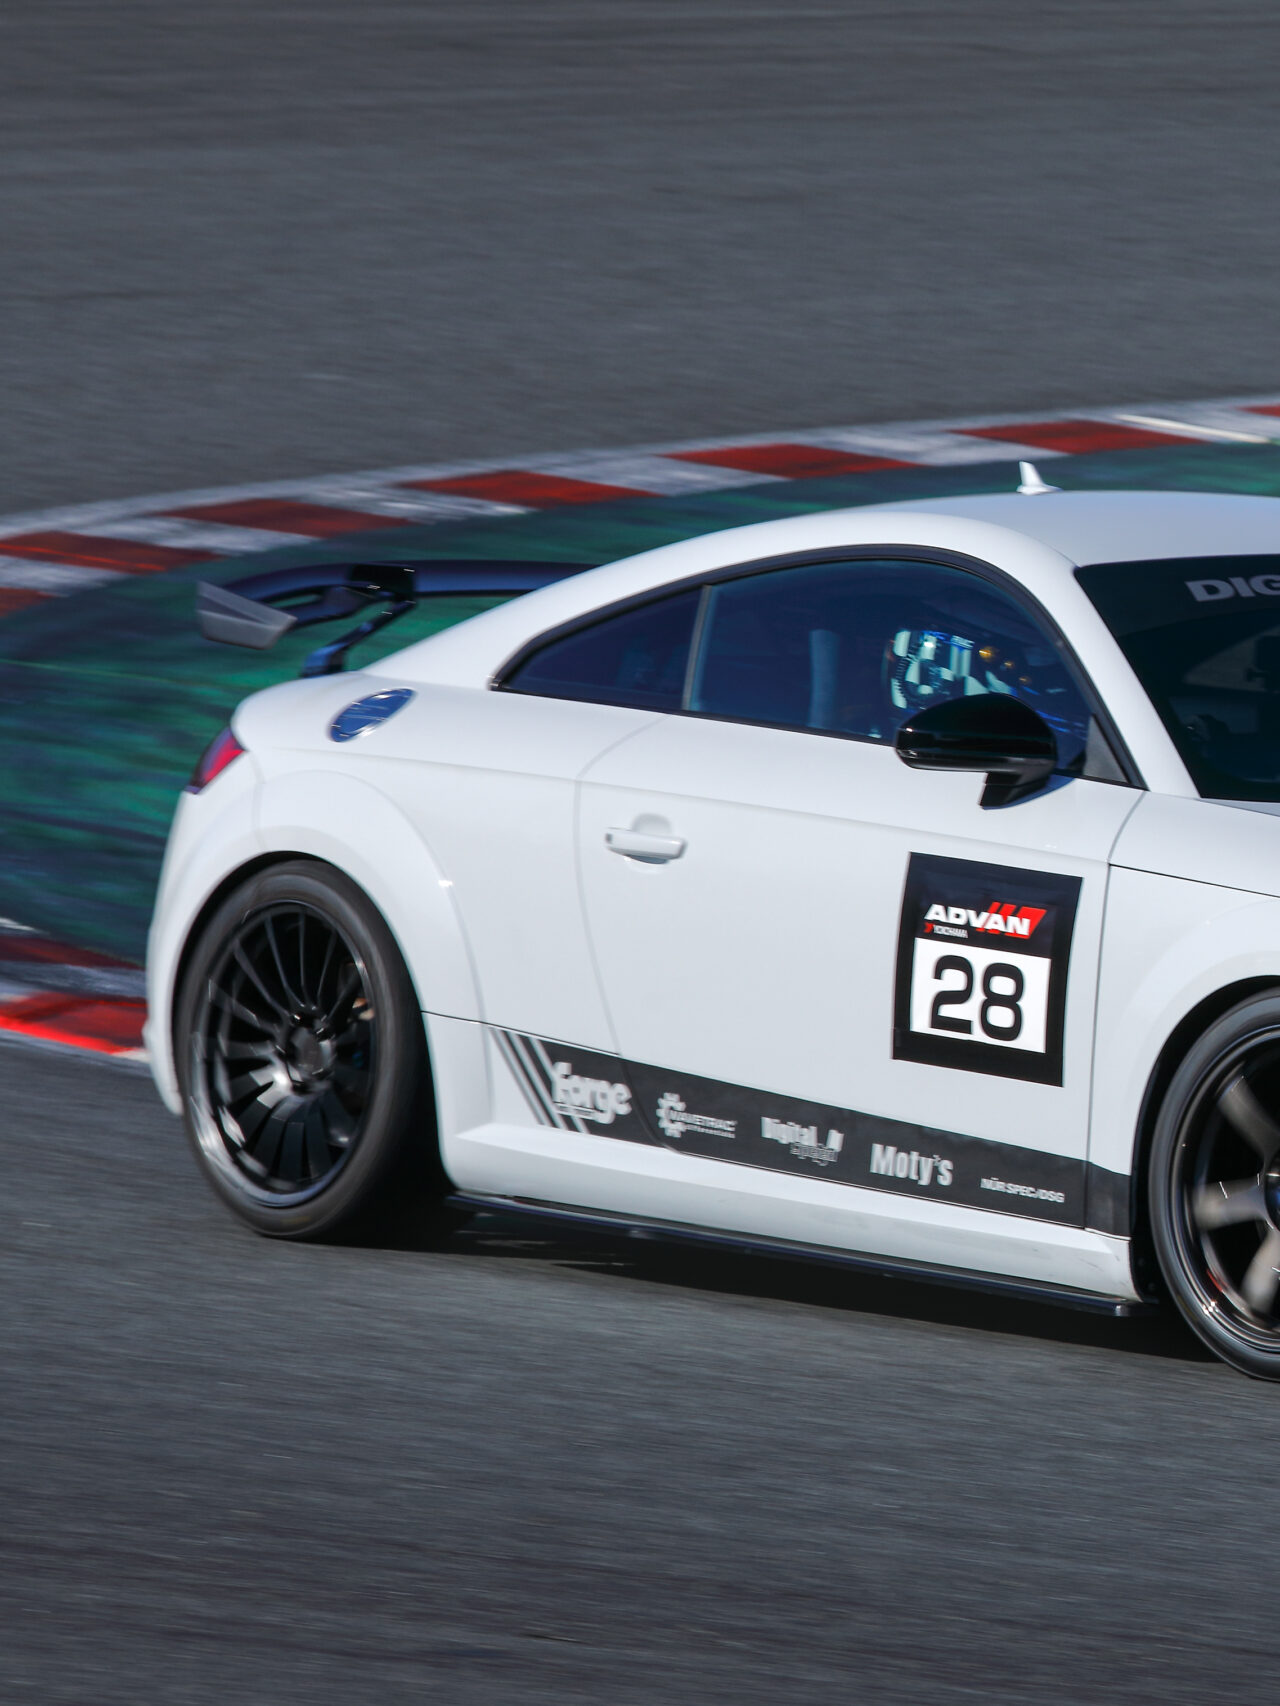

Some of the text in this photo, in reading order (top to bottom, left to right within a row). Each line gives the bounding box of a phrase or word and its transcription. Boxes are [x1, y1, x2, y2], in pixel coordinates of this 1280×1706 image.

[924, 903, 1031, 936] ADVAN
[930, 954, 1025, 1042] 28
[869, 1143, 954, 1187] Moty's
